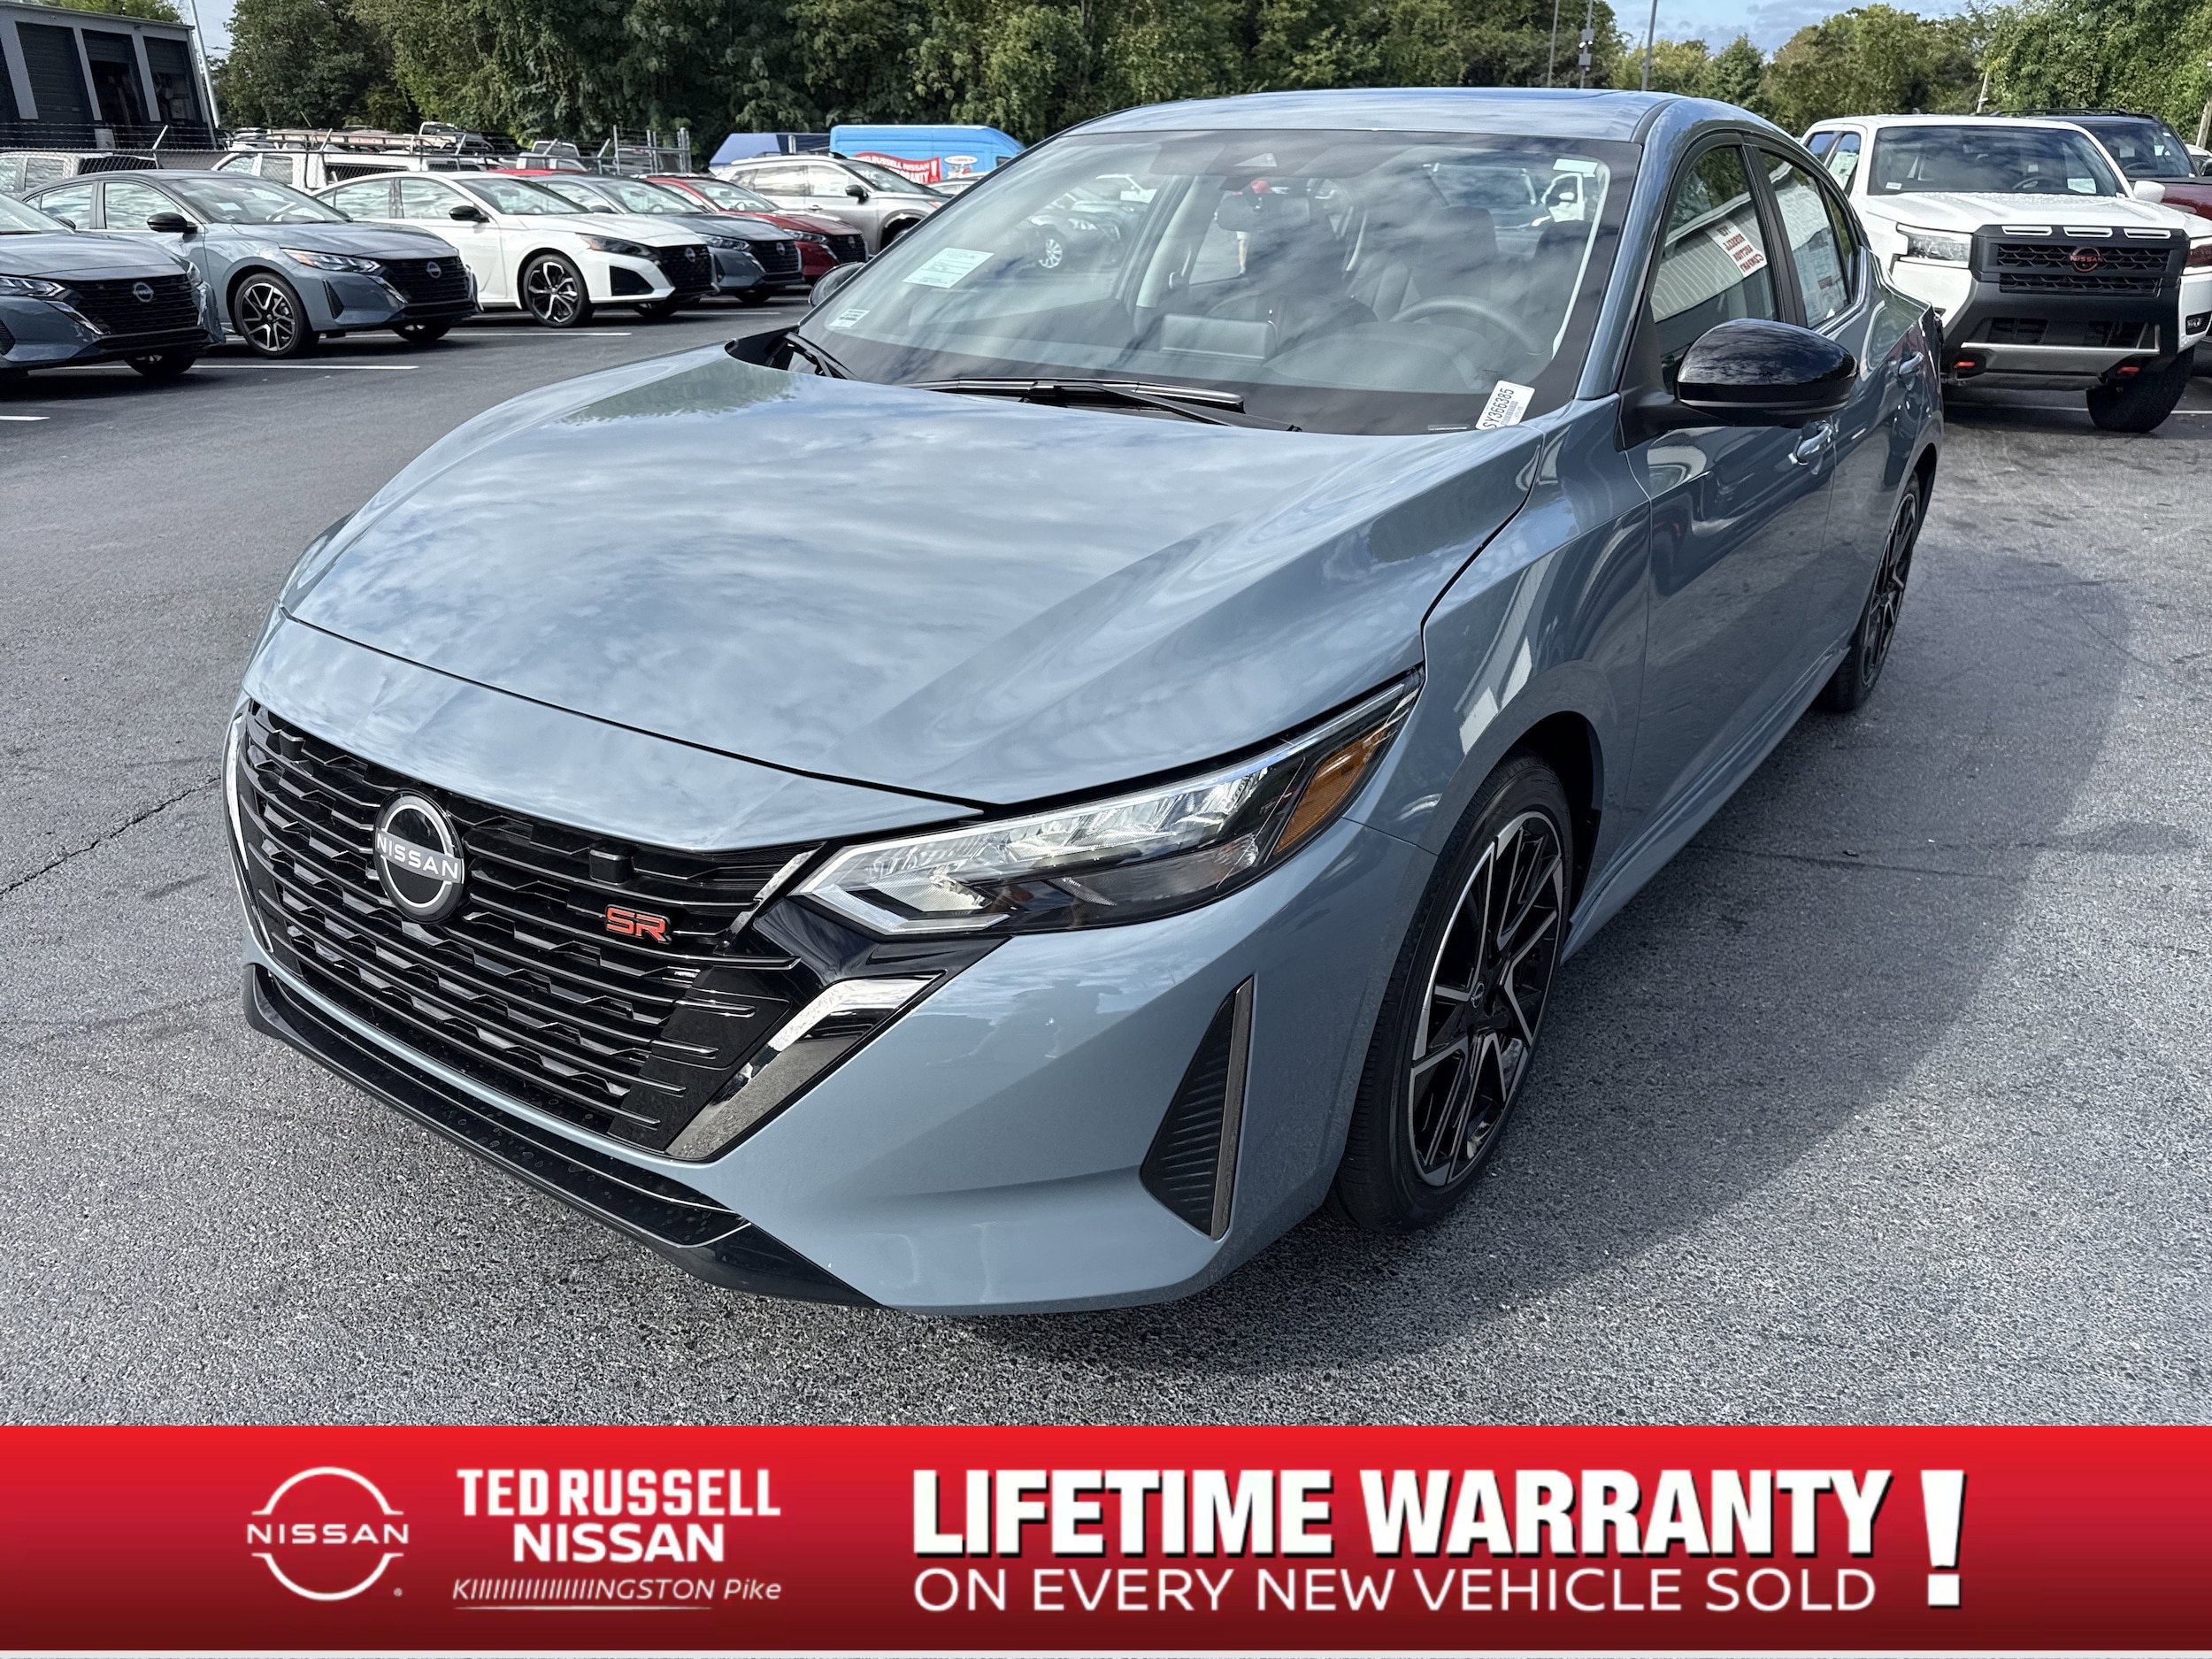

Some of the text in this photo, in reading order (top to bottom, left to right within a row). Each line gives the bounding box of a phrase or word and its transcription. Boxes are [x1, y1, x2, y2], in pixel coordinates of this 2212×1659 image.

[1482, 388, 1514, 428] SY366385
[377, 833, 458, 879] NISSAN
[605, 905, 669, 943] SR
